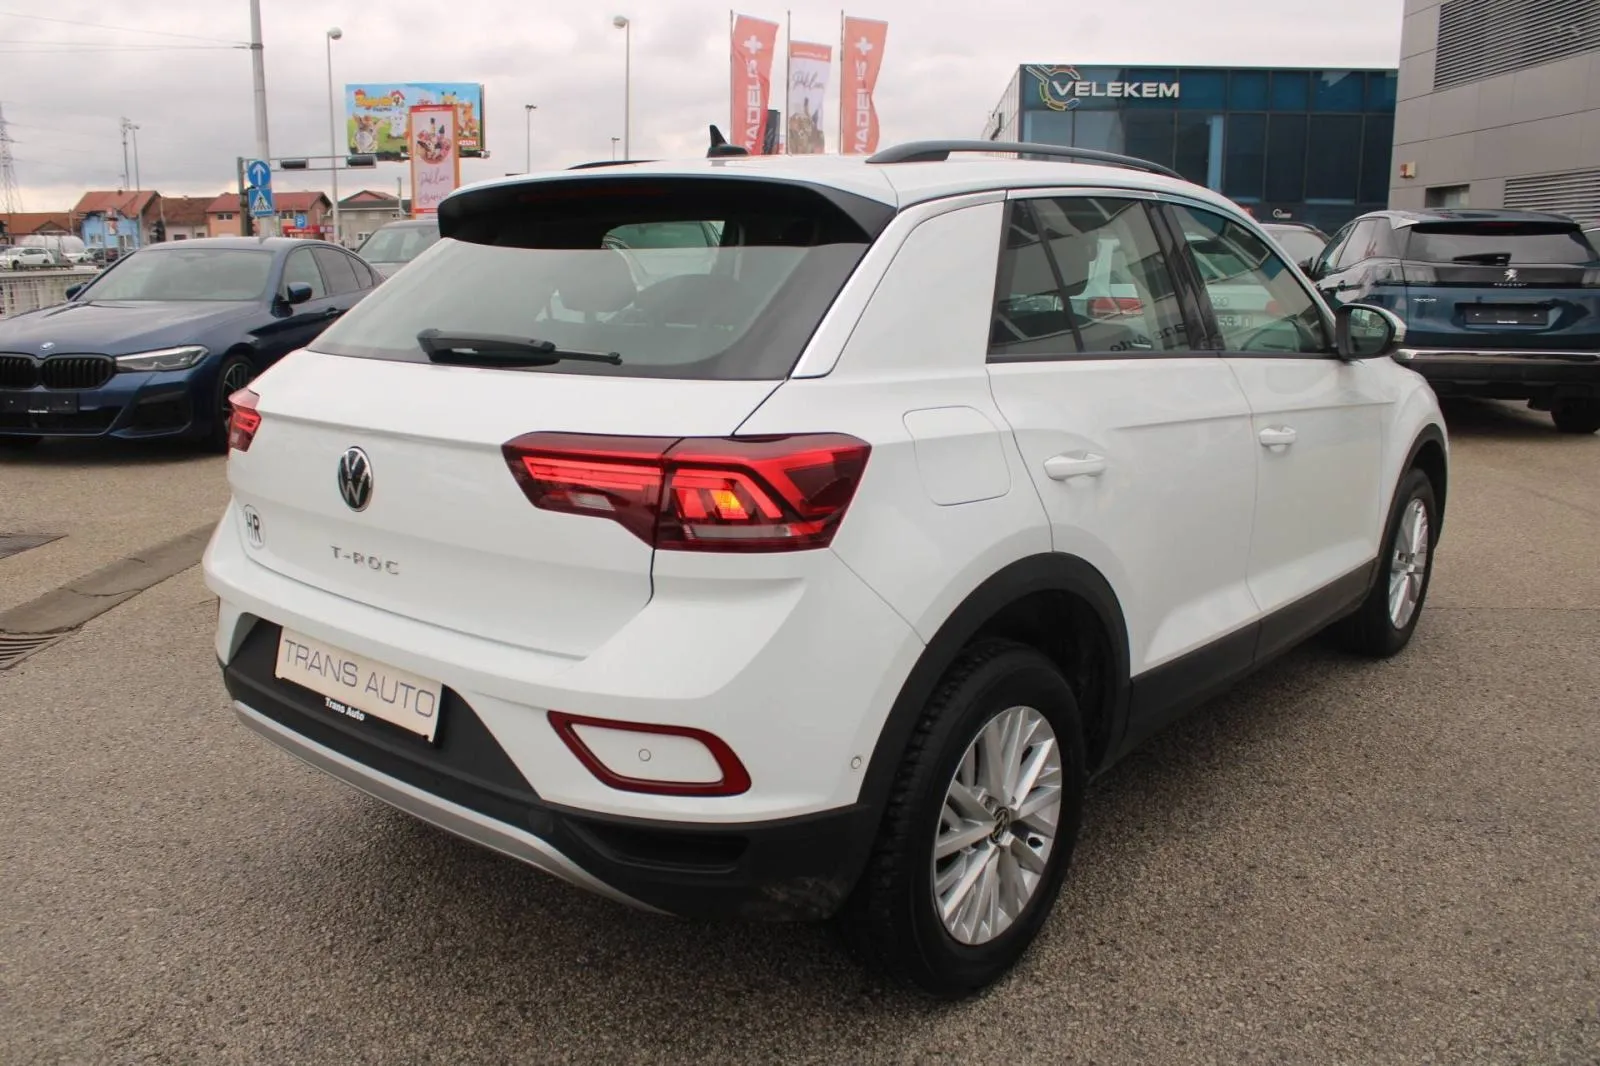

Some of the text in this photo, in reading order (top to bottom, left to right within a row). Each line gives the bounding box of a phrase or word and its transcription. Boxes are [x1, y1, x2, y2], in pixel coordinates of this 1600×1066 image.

[1051, 80, 1180, 98] VELEKEM
[245, 511, 262, 543] HR
[329, 545, 400, 576] T-ROC
[284, 639, 436, 719] TRANS AUTO
[325, 697, 365, 722] Trans Auto
